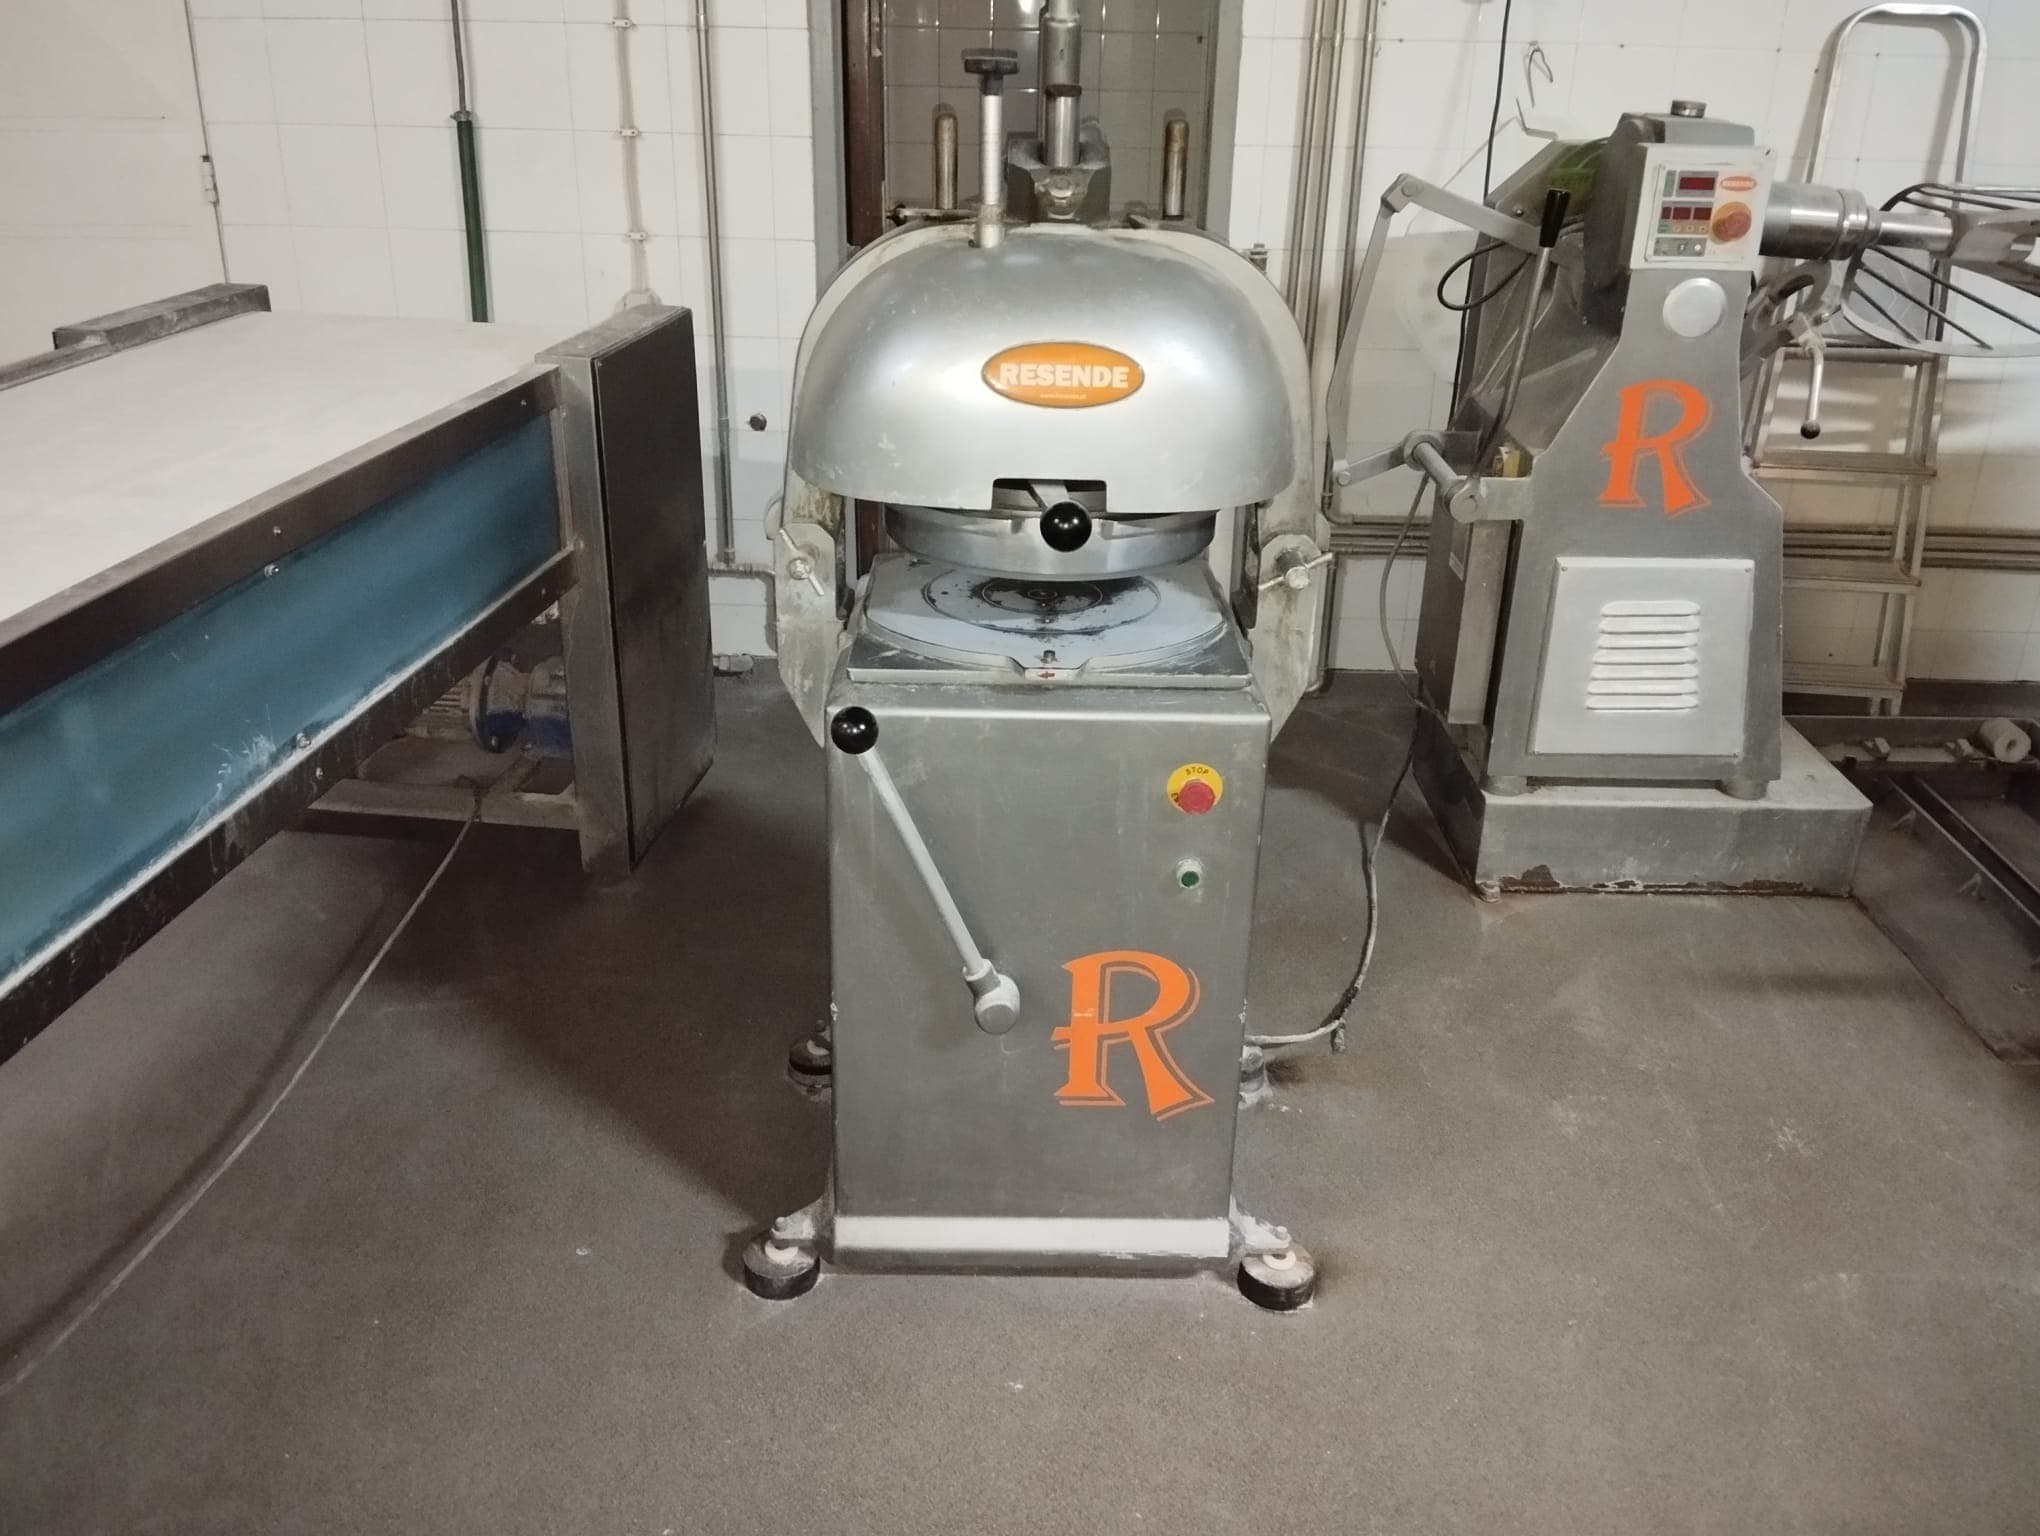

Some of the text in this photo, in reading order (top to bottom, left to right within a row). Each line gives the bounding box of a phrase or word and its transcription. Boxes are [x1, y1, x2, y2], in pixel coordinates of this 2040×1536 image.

[999, 362, 1129, 388] RESENDE
[1598, 380, 1712, 519] R
[1185, 766, 1209, 775] STOP
[1051, 950, 1215, 1122] R
